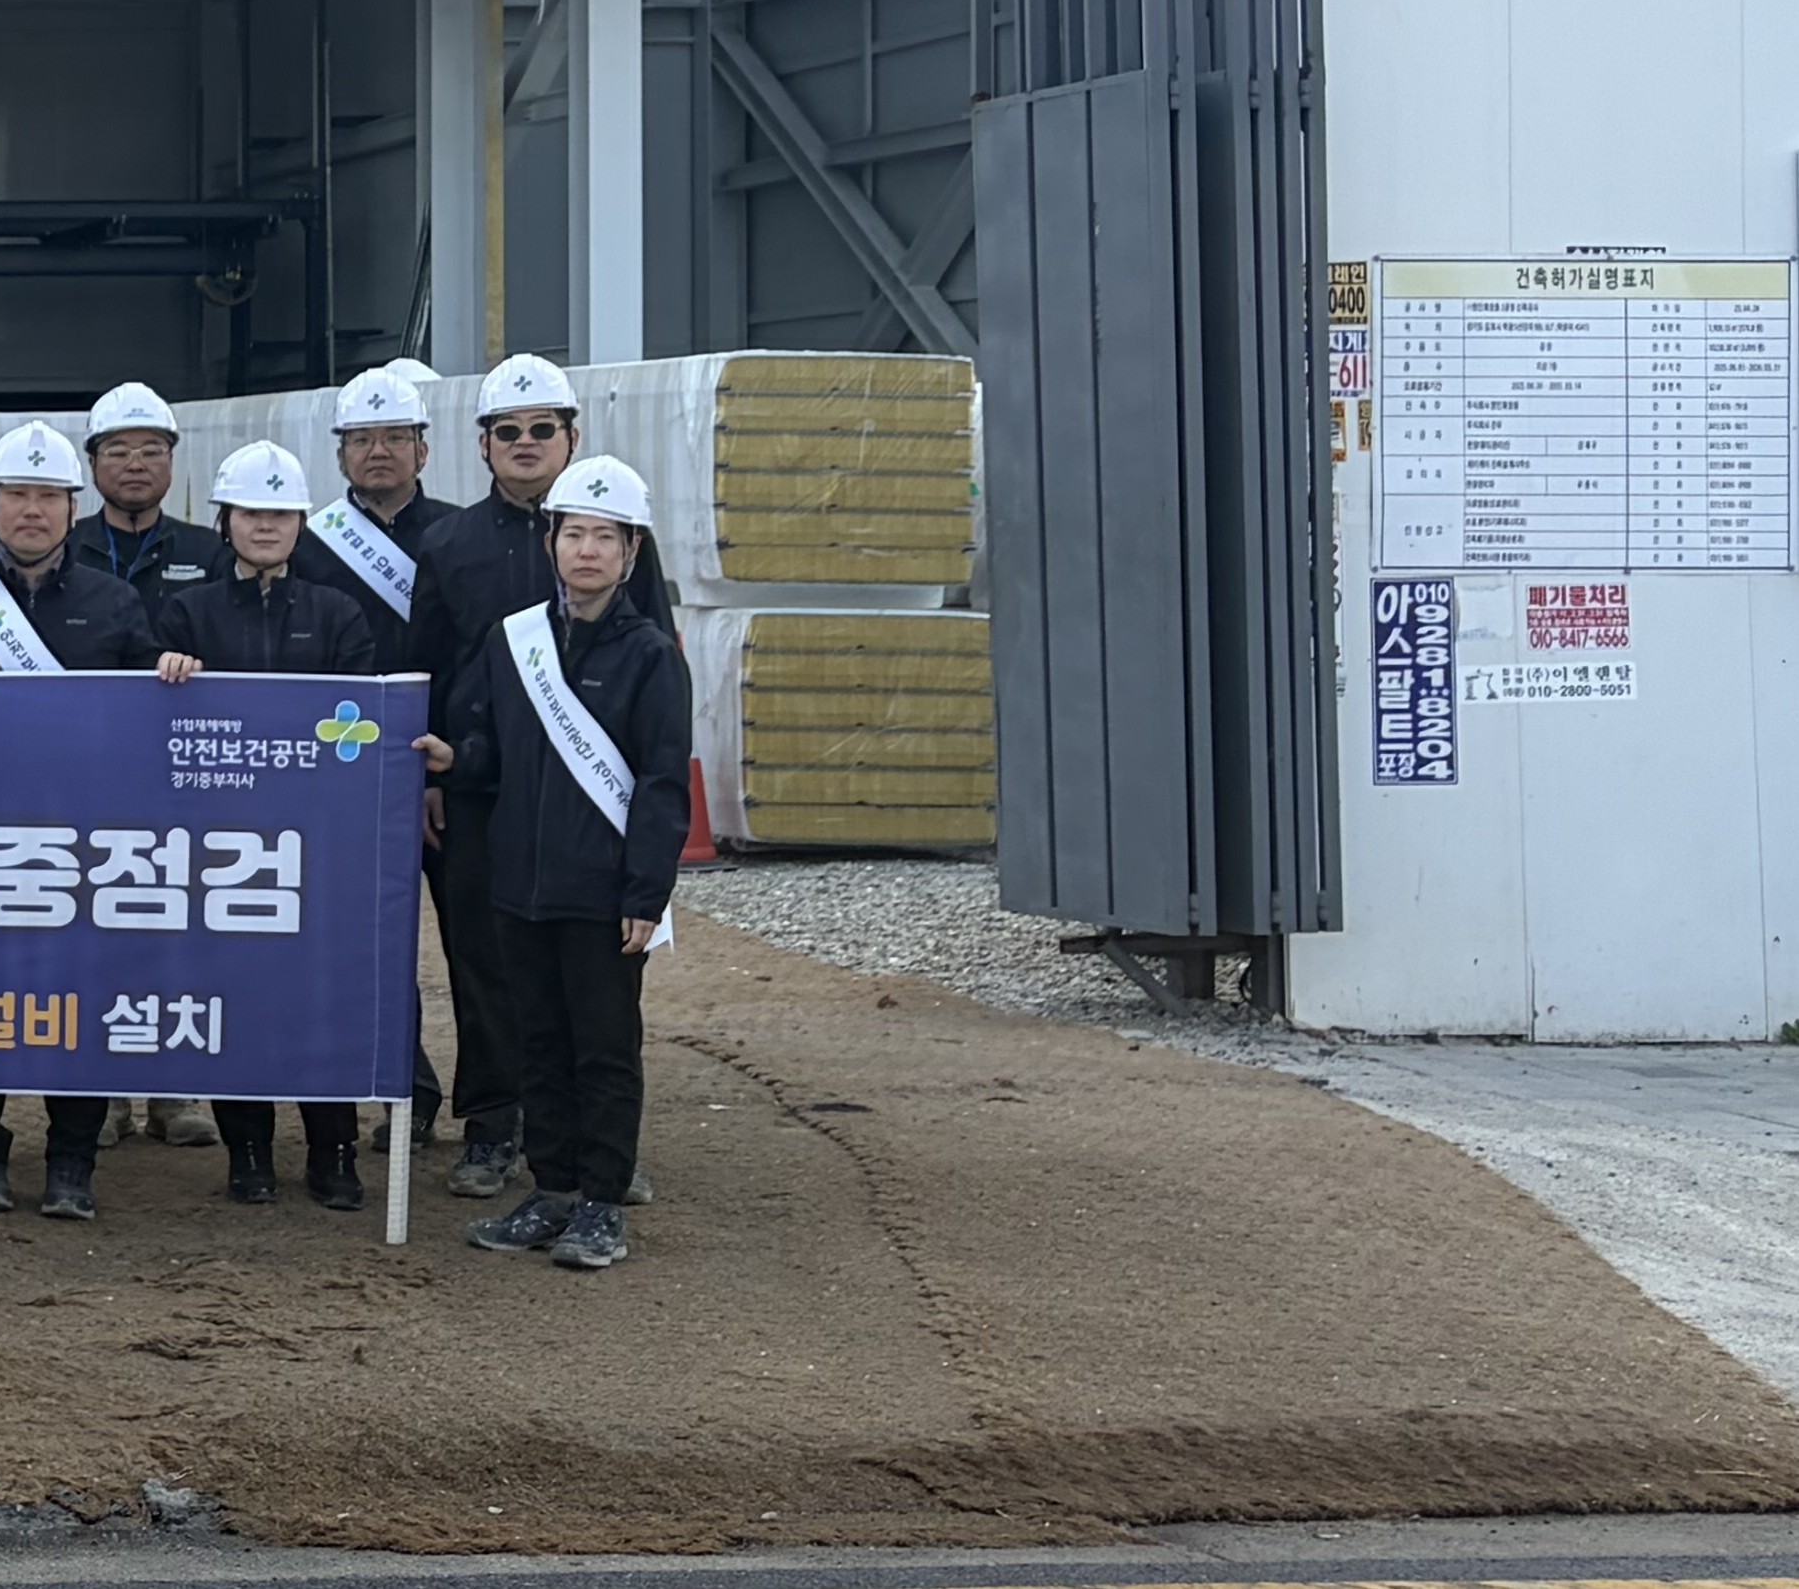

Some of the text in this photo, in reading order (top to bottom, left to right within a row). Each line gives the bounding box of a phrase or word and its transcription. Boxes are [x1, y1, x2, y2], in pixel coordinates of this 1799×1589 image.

[1329, 263, 1365, 283] 레인
[1516, 266, 1655, 291] 건축허가실명표지
[1376, 584, 1415, 751] 아스팔트
[167, 737, 321, 769] 안전보건공단
[170, 771, 256, 790] 경기중부지사
[101, 991, 224, 1055] 설치
